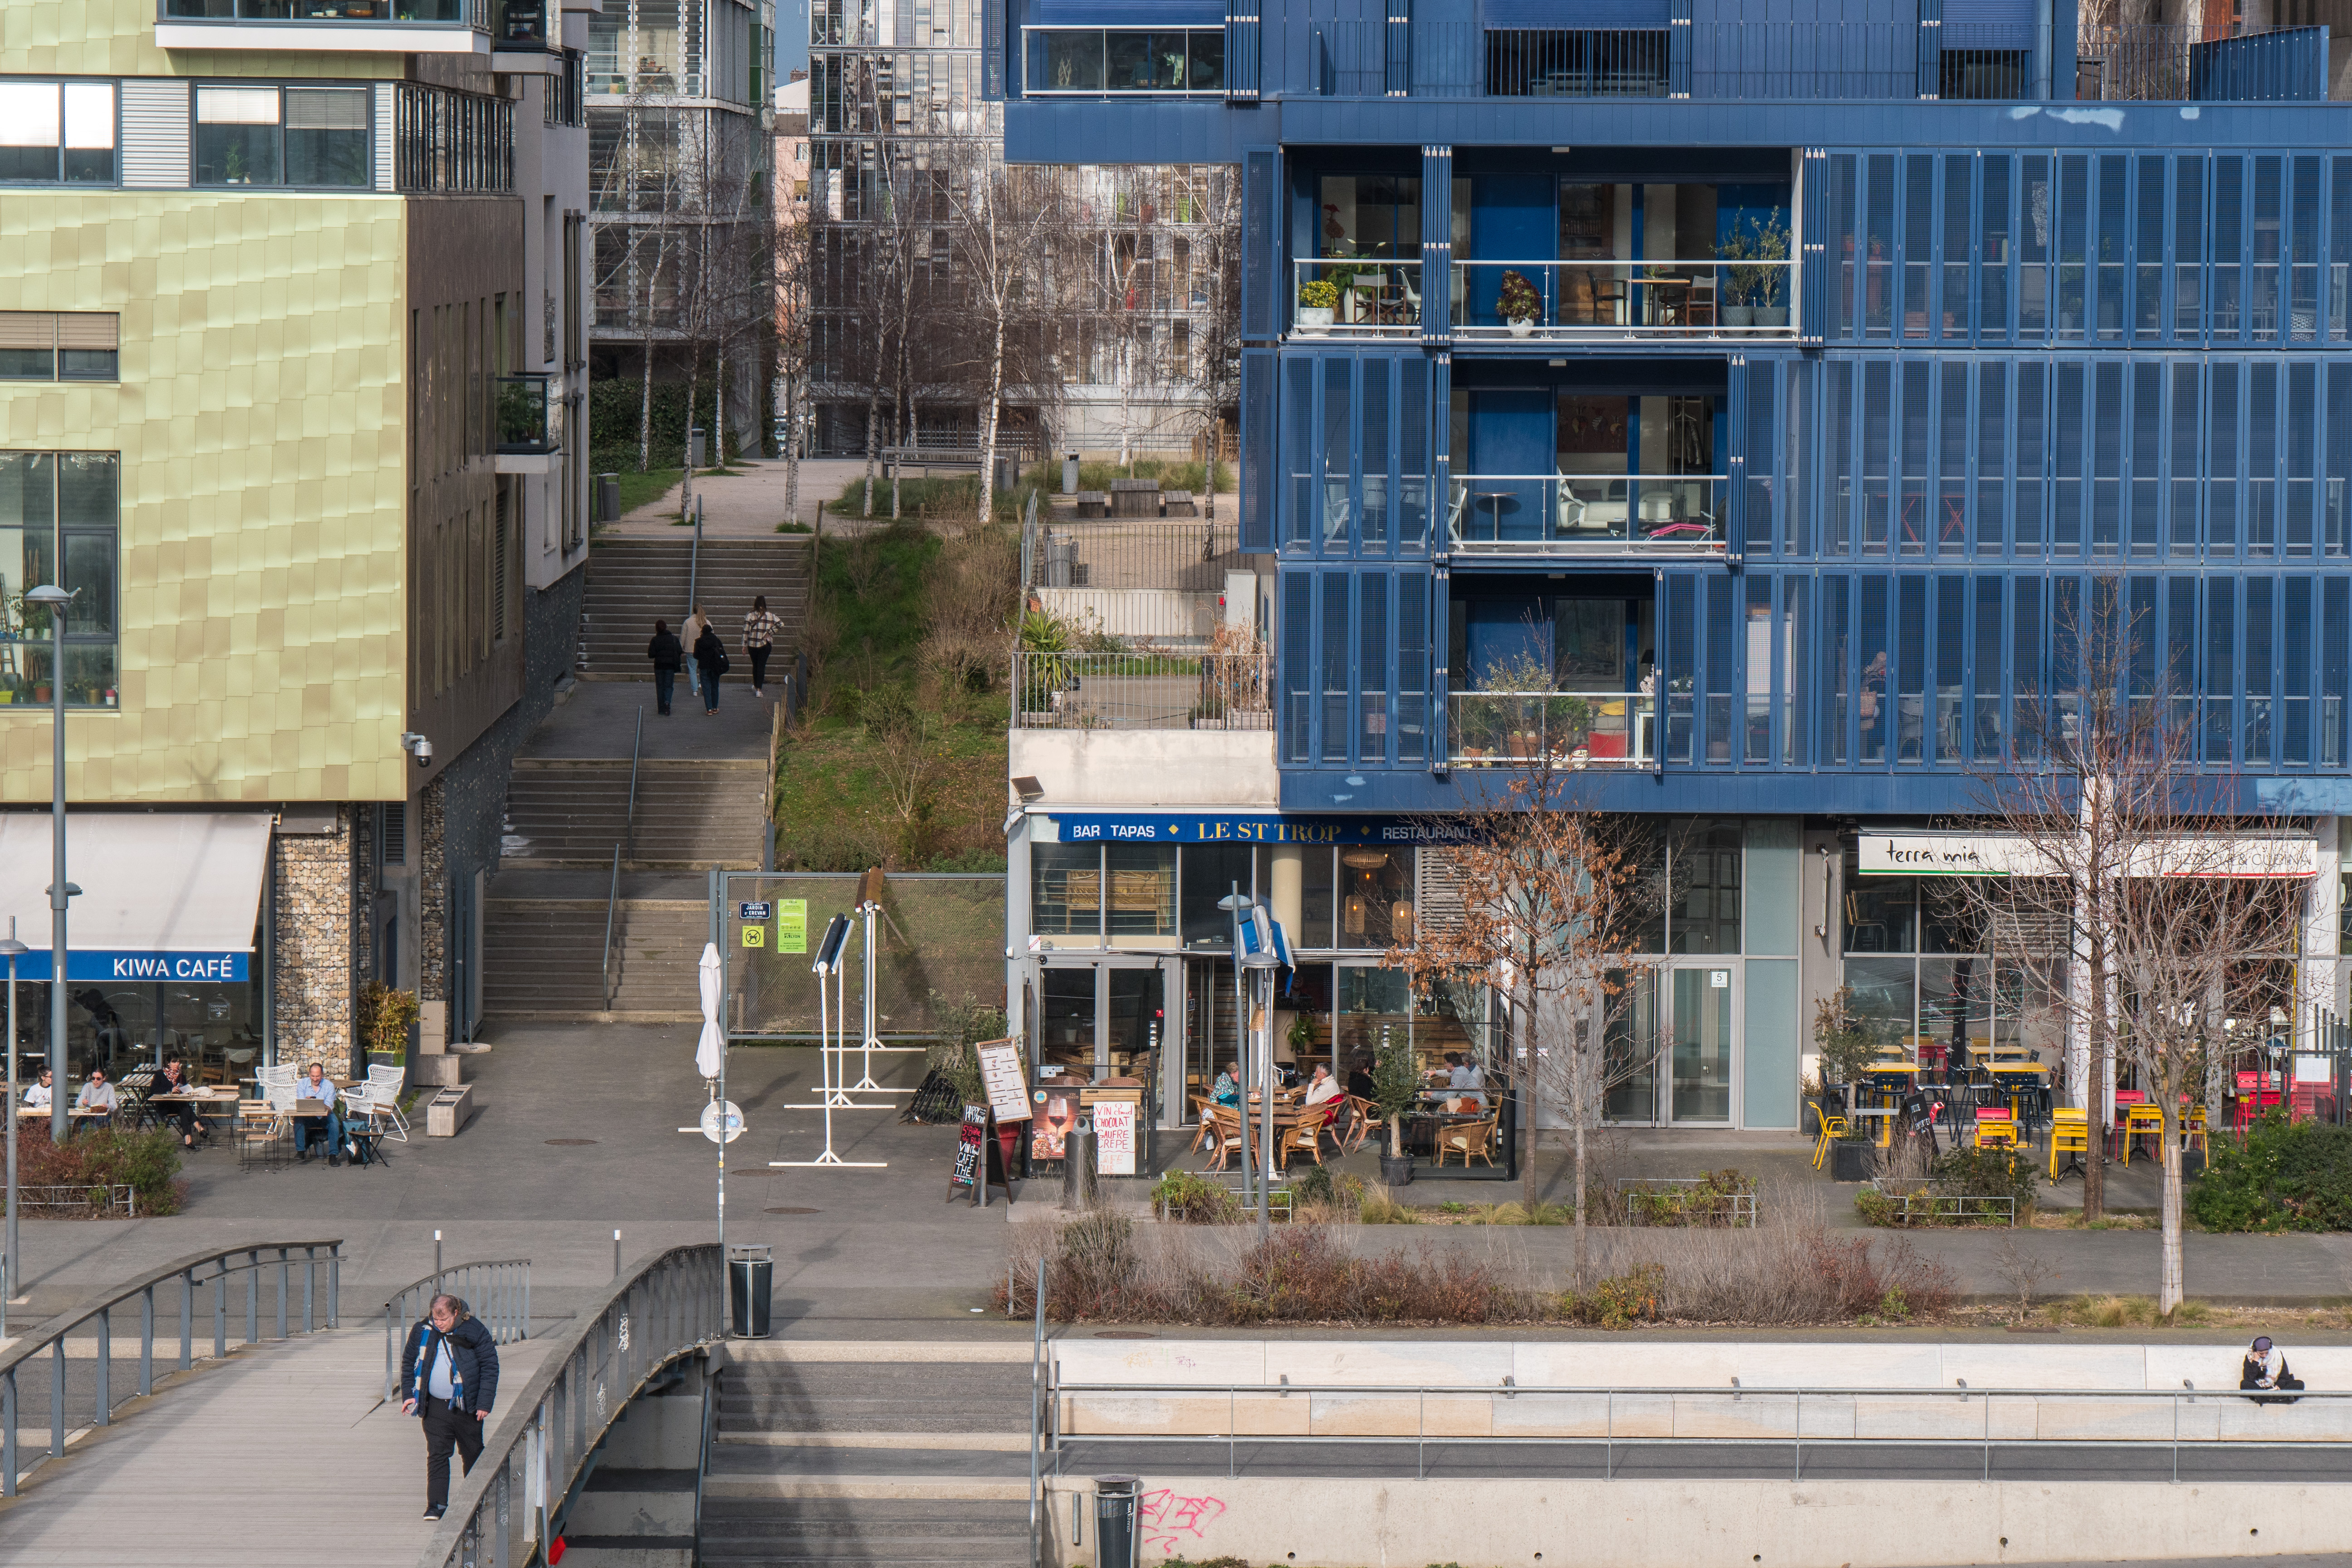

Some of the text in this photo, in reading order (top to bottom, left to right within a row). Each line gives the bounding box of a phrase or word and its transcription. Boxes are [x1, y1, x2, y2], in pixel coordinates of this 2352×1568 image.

[1073, 825, 1155, 838] BAR TAPAS
[1197, 822, 1341, 842] LE ST TROP
[1382, 826, 1474, 839] RESTAURANT
[1886, 839, 1980, 863] terra mia
[2238, 853, 2247, 865] &
[2252, 853, 2312, 866] CUCINA
[113, 955, 232, 977] KIWA CAFÉ
[1717, 973, 1722, 981] 5
[965, 1104, 981, 1122] HAPPY
[975, 1115, 985, 1124] HOUR
[1095, 1116, 1130, 1128] CHOCOLAT
[1097, 1129, 1129, 1139] GAUFRE
[957, 1152, 975, 1166] CAFÉ
[956, 1162, 972, 1177] THÉ
